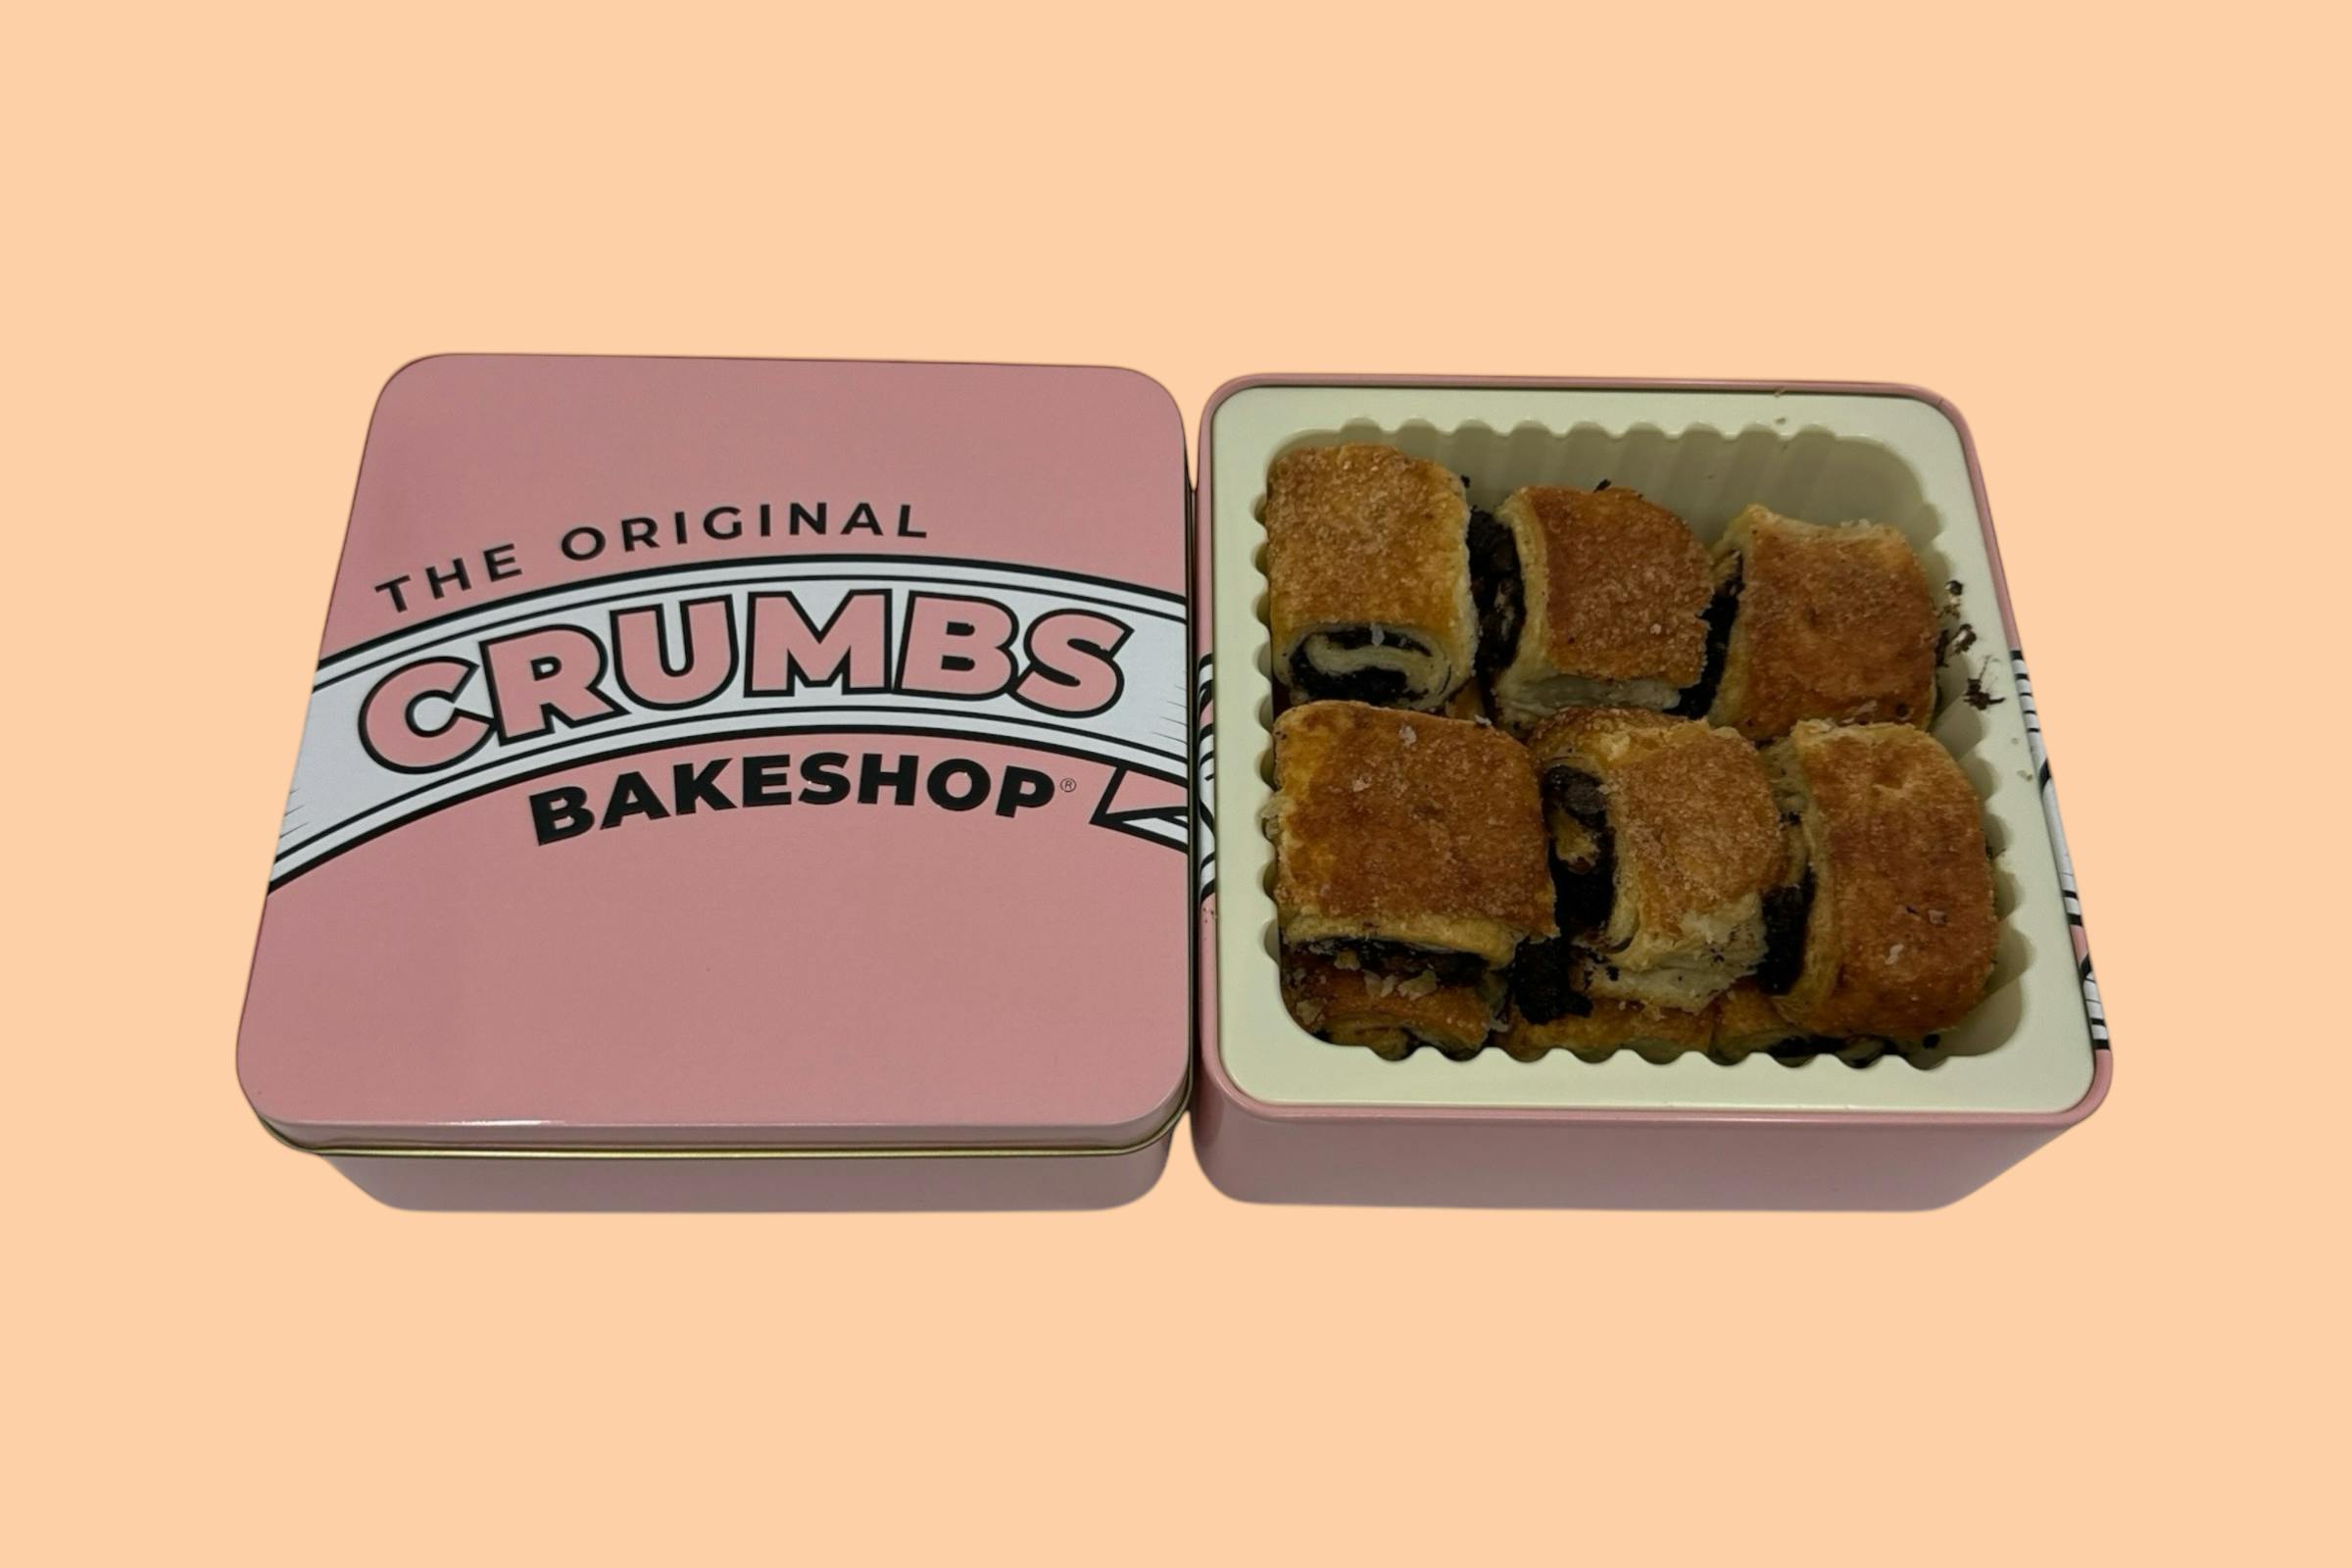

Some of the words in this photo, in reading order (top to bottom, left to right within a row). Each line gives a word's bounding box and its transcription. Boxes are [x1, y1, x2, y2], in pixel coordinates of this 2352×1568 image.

[374, 543, 523, 613] THE
[561, 502, 928, 562] ORIGINAL
[357, 588, 1135, 775] CRUMBS
